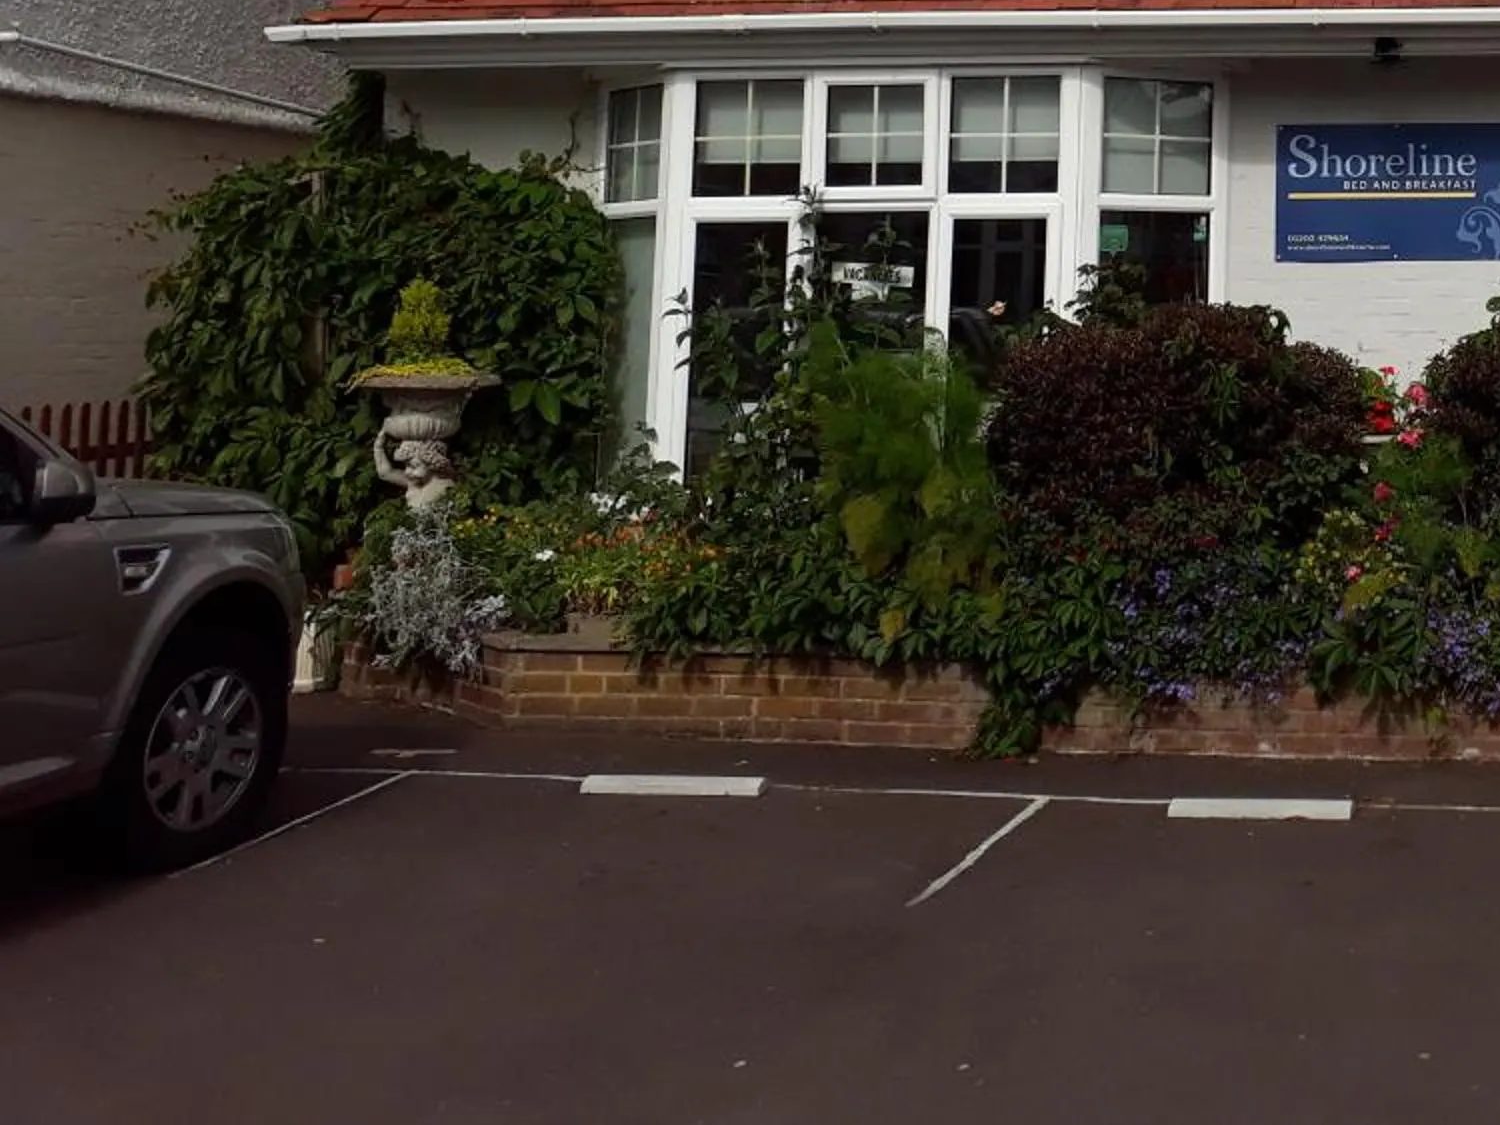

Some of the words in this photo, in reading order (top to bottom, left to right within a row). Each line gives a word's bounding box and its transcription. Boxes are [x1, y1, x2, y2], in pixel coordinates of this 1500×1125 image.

[1287, 133, 1477, 178] Shoreline
[1343, 179, 1368, 191] BED
[1373, 179, 1401, 191] AND
[1405, 178, 1477, 191] BREAKFAST
